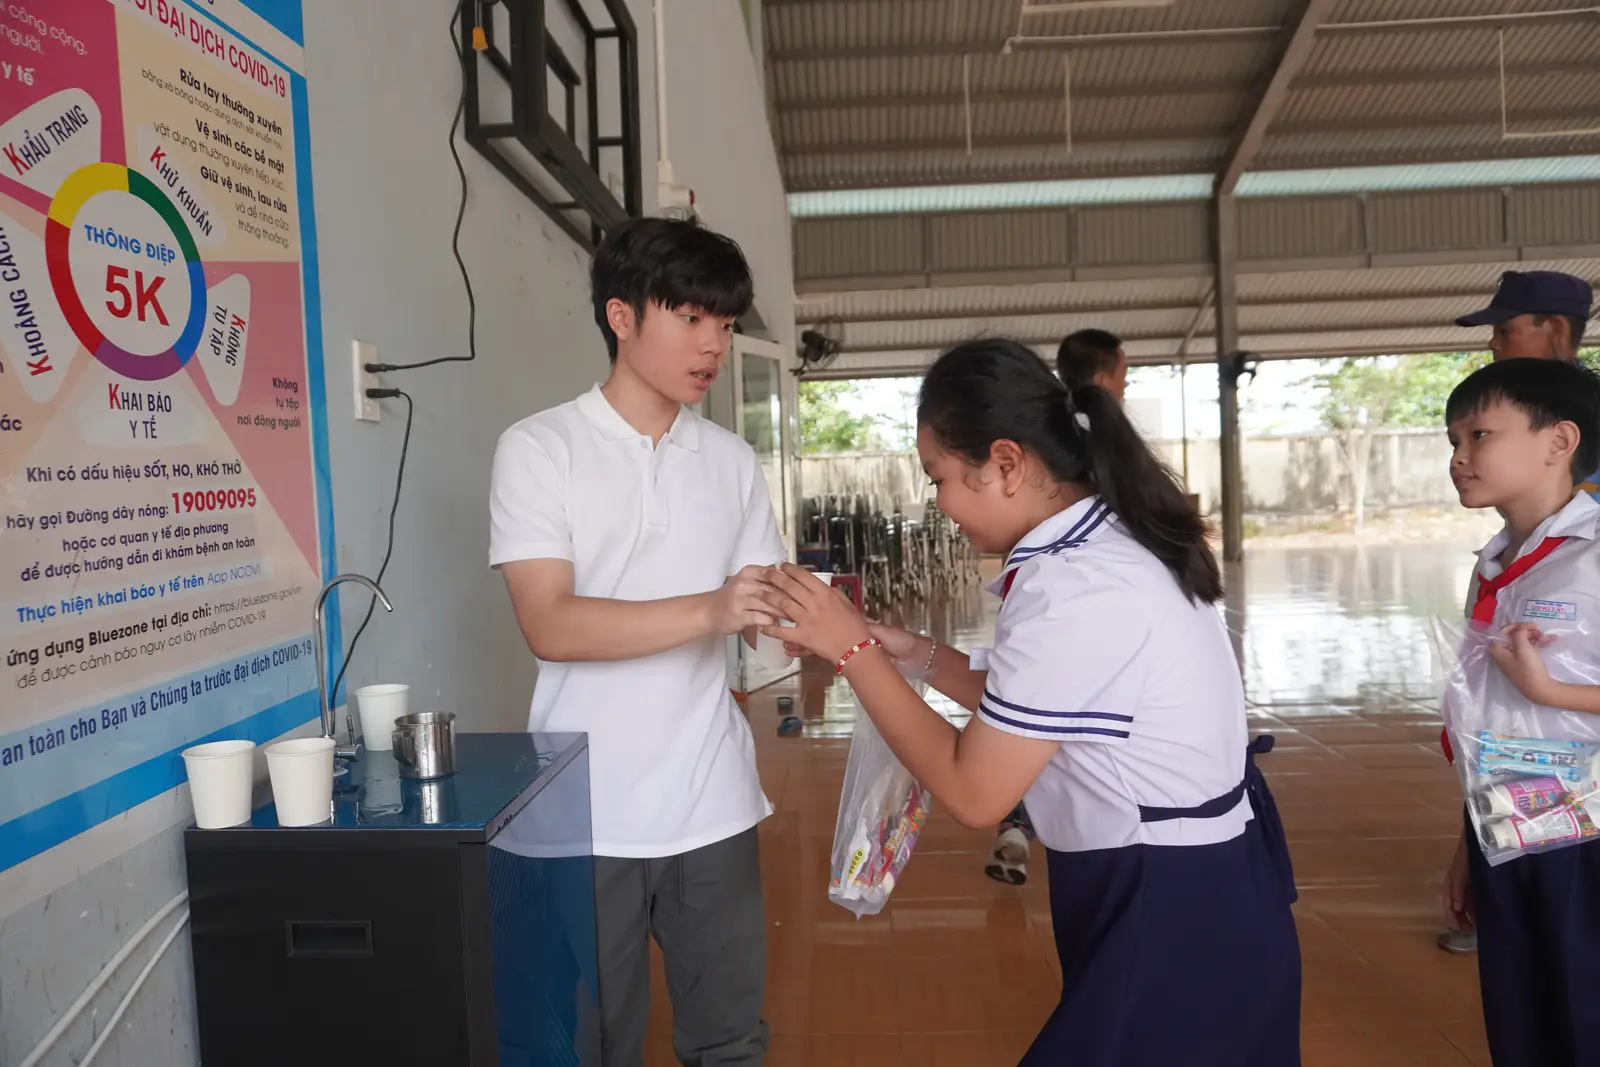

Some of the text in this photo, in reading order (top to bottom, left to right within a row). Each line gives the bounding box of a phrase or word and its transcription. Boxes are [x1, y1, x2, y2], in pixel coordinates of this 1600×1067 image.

[9, 5, 47, 36] công
[2, 61, 12, 79] y
[157, 0, 286, 98] ĐẠI DỊCH COVID-19
[180, 68, 283, 136] Rửa tay thường xuyên
[45, 105, 89, 146] TRANG
[195, 118, 284, 174] Vệ sinh các bề mặt
[172, 130, 197, 152] dụng
[199, 143, 230, 167] thường
[231, 158, 254, 177] xuyên
[150, 145, 212, 236] KHỬ KHUẨN
[200, 165, 288, 213] Giữ vệ sinh, lau rửa
[235, 201, 246, 213] và
[259, 210, 274, 225] nhà
[238, 220, 261, 239] thông
[84, 224, 175, 266] THÔNG ĐIỆP
[106, 264, 169, 326] 5K
[10, 289, 53, 377] KHOẢNG
[208, 305, 227, 356] TỤ TẬP
[225, 313, 246, 366] KHÔNG
[108, 383, 172, 412] KHAI BÁO
[272, 377, 298, 393] Không
[286, 397, 299, 412] tập
[129, 415, 157, 438] Y TẾ
[237, 414, 301, 430] nơi đông người
[26, 459, 242, 482] Khi có dấu hiệu SỐT, HO, KHÓ THỞ
[6, 488, 257, 530] hãy gọi Đường dây nóng: 19009095
[20, 536, 255, 581] để được hướng dẫn đi khám bệnh an toàn
[62, 523, 228, 552] hoặc cơ quan y tế địa phương
[17, 563, 262, 623] Thực hiện khai báo y tế trên App NCOVI
[7, 649, 39, 667] ứng
[44, 638, 84, 658] dụng
[88, 622, 149, 647] Bluezone
[151, 615, 168, 633] tại
[170, 611, 189, 628] địa
[192, 602, 212, 620] chỉ:
[17, 610, 267, 689] để được cảnh báo nguy cơ lây nhiễm COVID-19
[2, 639, 312, 767] an toàn cho Bạn và Chúng ta trước đại dịch COVID-19
